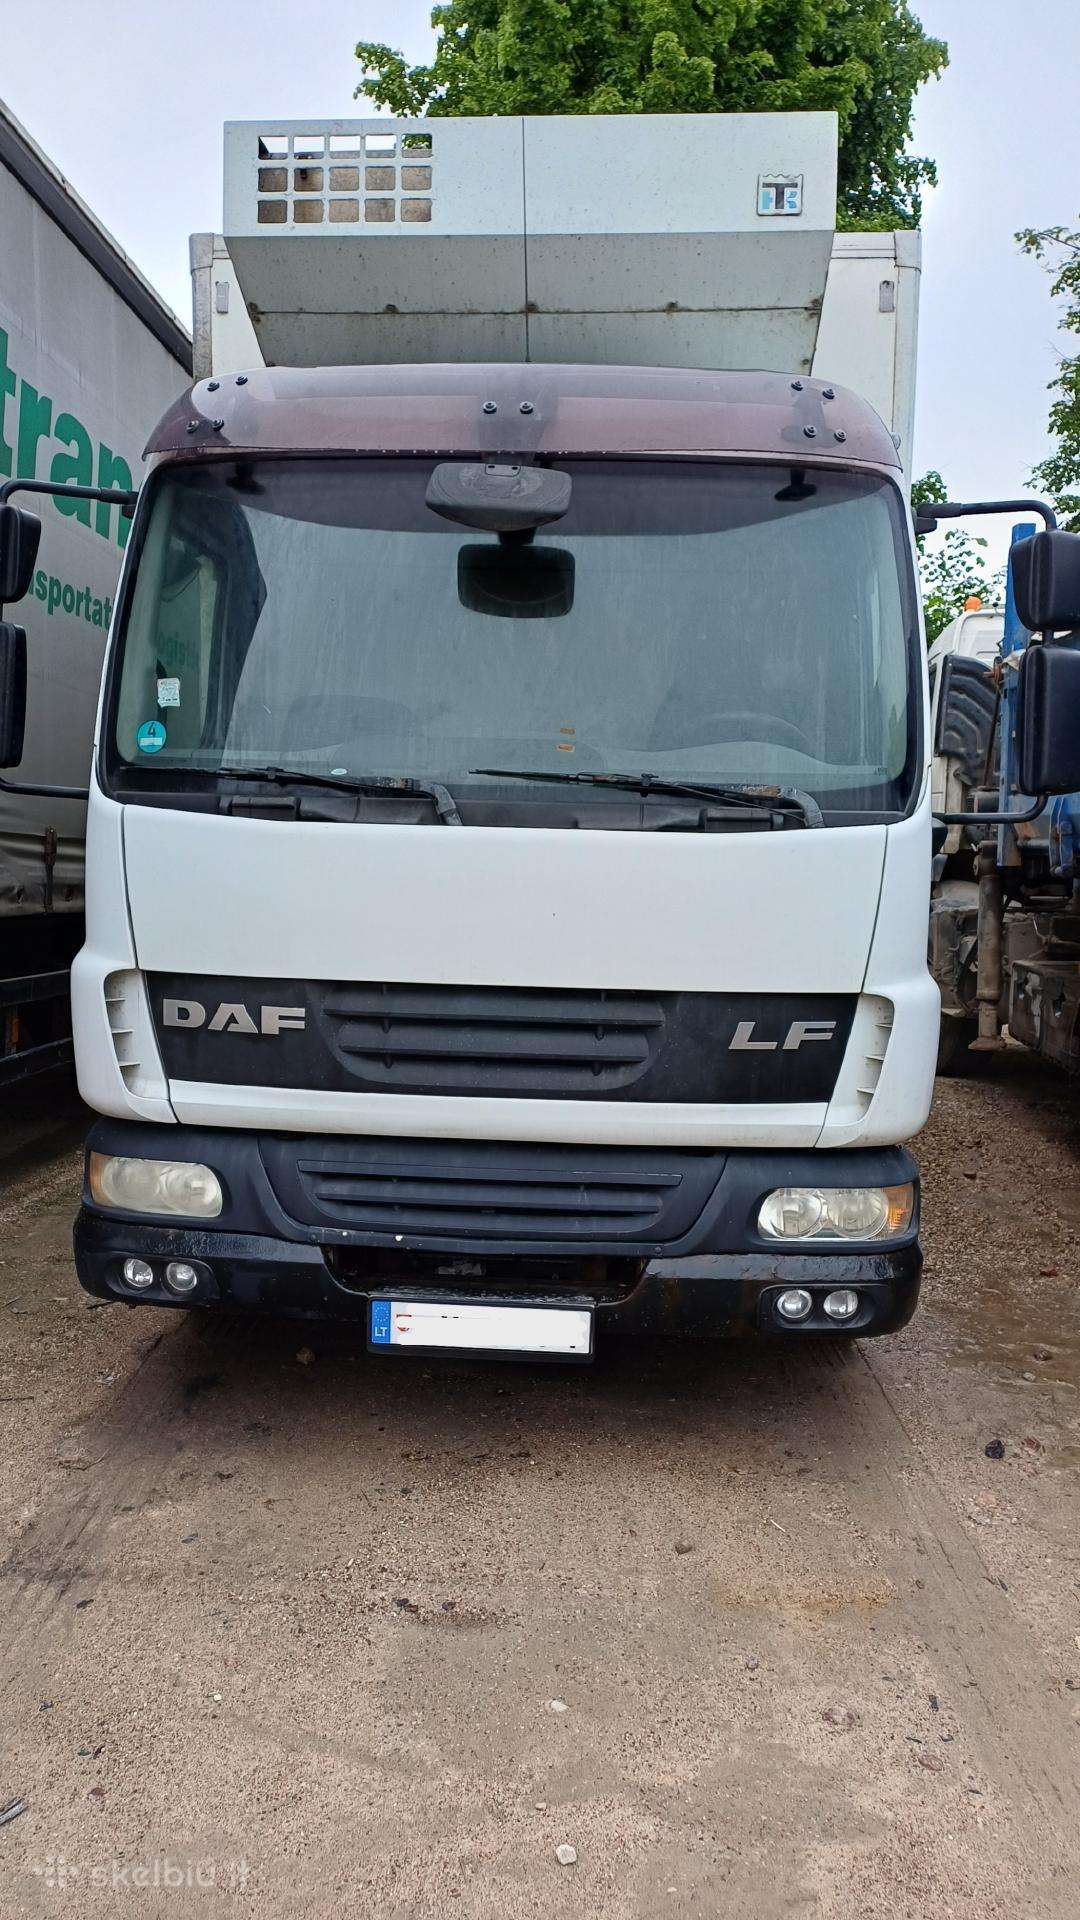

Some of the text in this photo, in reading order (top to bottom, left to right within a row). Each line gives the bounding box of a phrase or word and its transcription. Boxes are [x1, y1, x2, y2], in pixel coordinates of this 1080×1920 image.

[163, 998, 306, 1035] DAF
[728, 1021, 837, 1050] LF
[374, 1326, 388, 1337] LT
